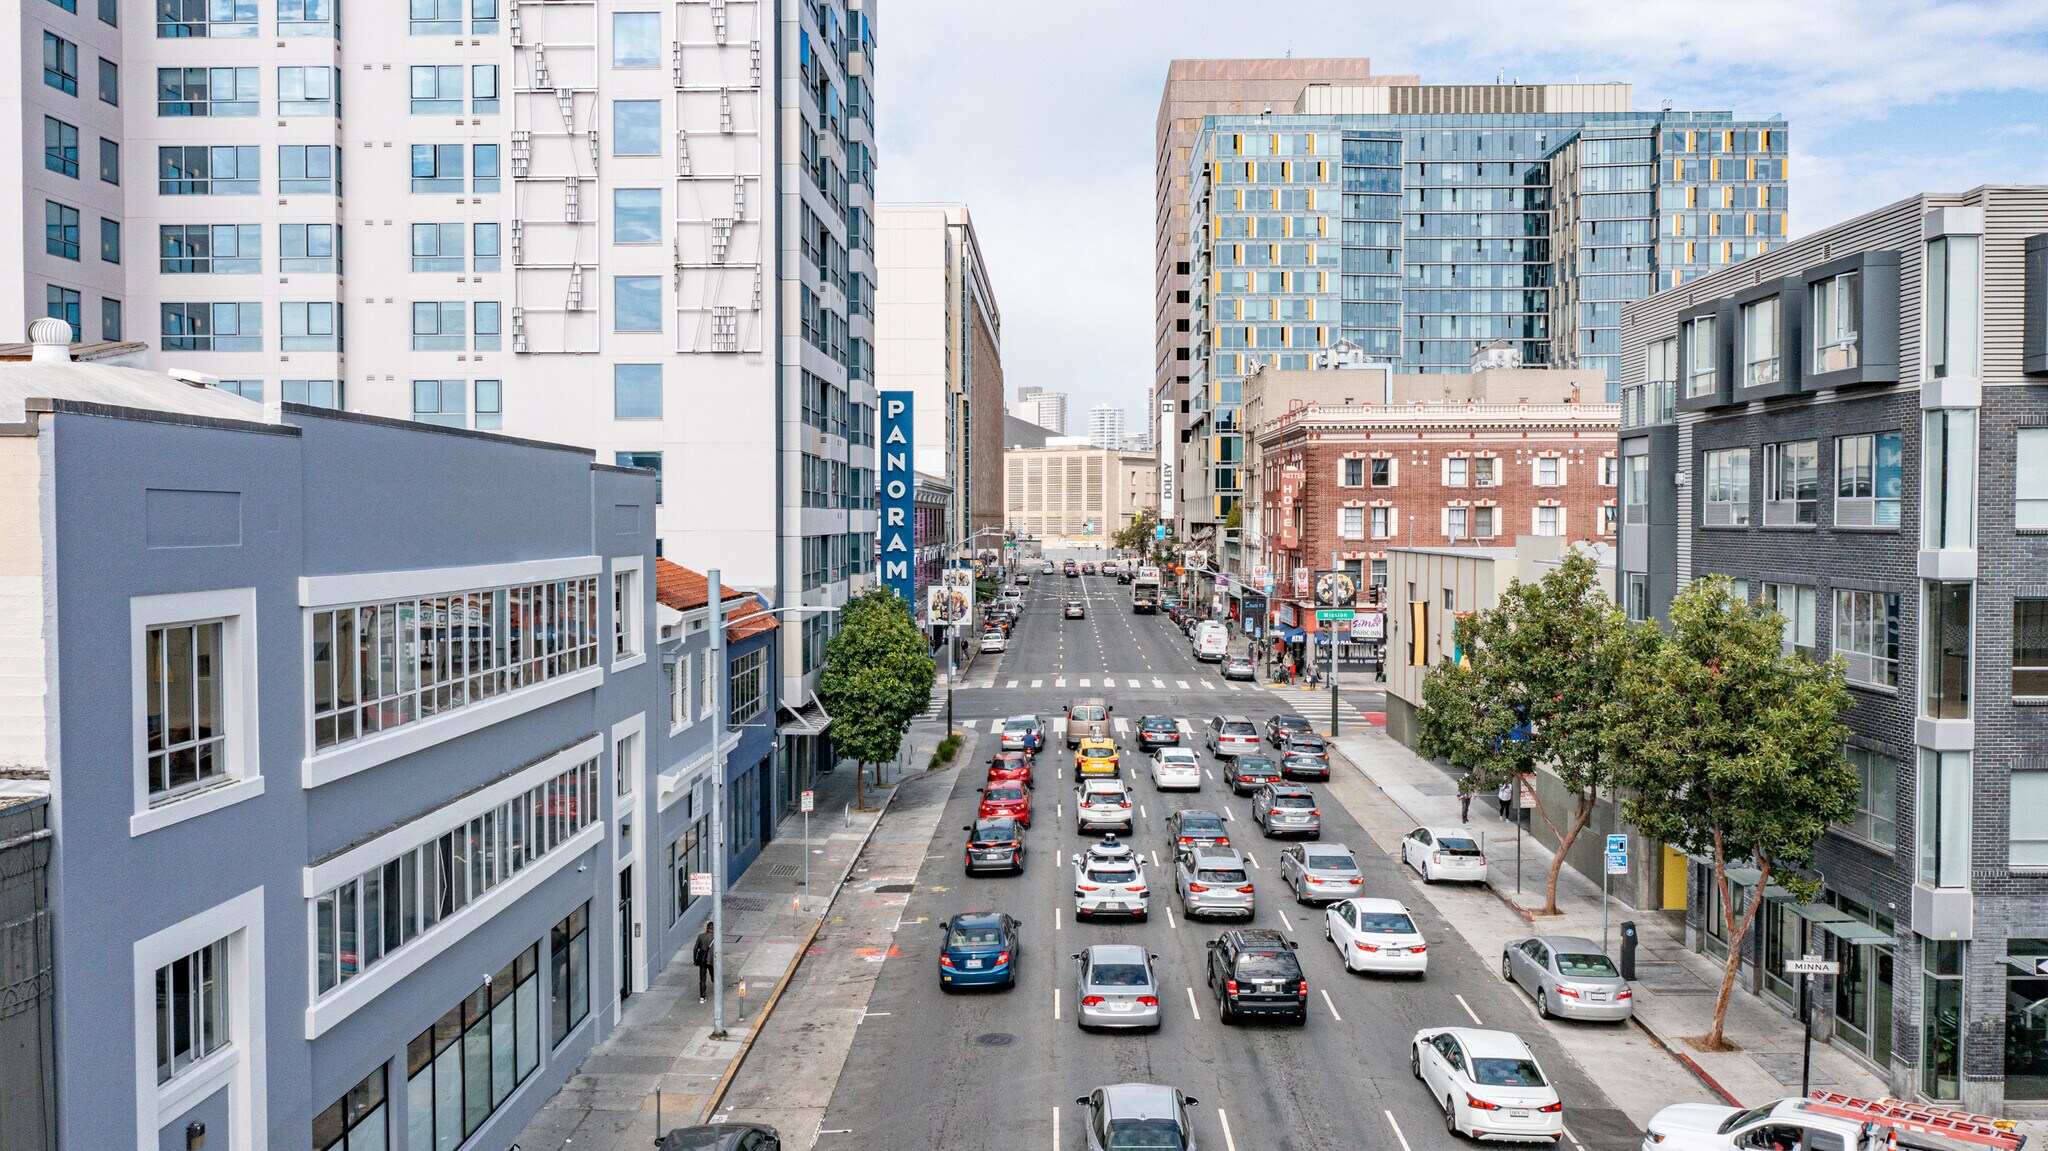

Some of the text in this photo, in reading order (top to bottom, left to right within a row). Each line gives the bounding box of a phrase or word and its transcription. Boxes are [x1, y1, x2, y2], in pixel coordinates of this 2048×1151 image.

[1163, 463, 1173, 500] DOLBY
[1283, 484, 1293, 538] HOTEL
[1348, 644, 1378, 658] MARKE
[1794, 963, 1830, 971] MINNA
